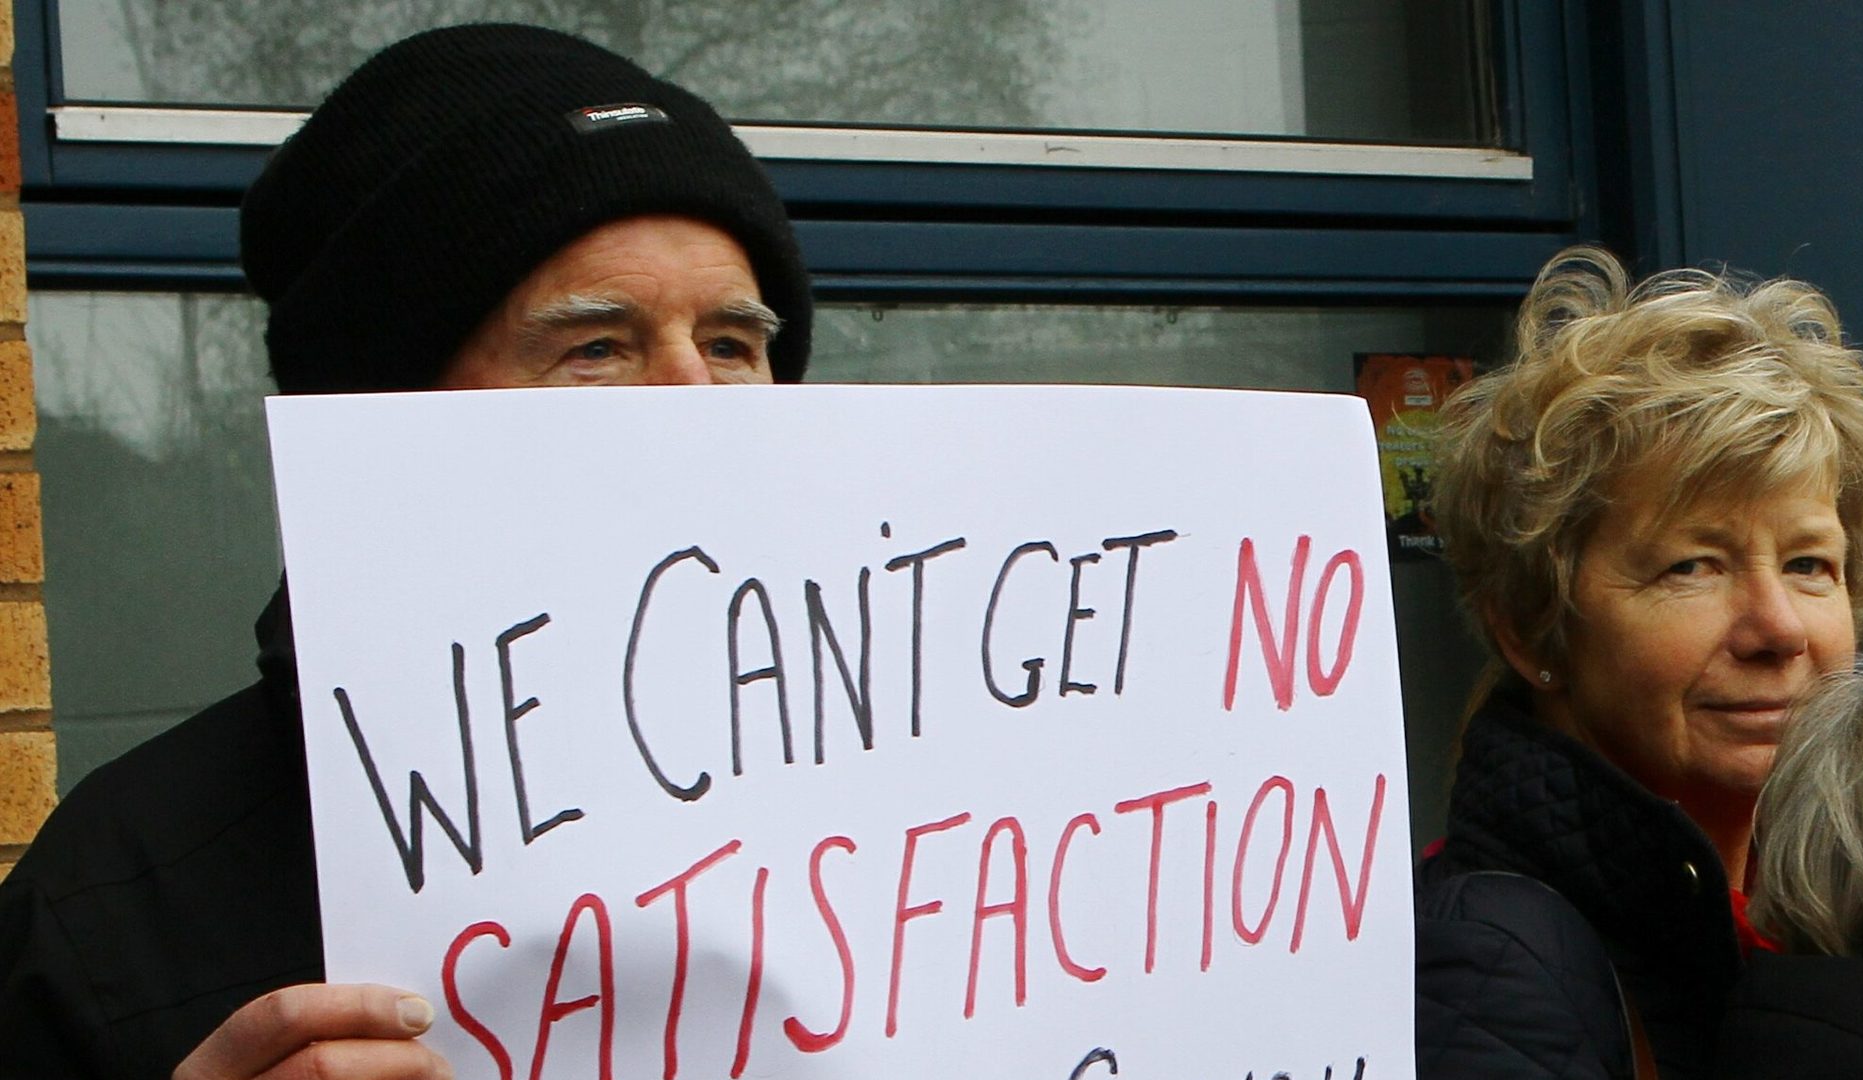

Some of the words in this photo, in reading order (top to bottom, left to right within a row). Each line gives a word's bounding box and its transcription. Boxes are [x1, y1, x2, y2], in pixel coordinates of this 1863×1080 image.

[333, 612, 586, 894] WE
[622, 521, 967, 802] CAN'T
[980, 529, 1184, 708] GET
[1223, 534, 1365, 711] NO
